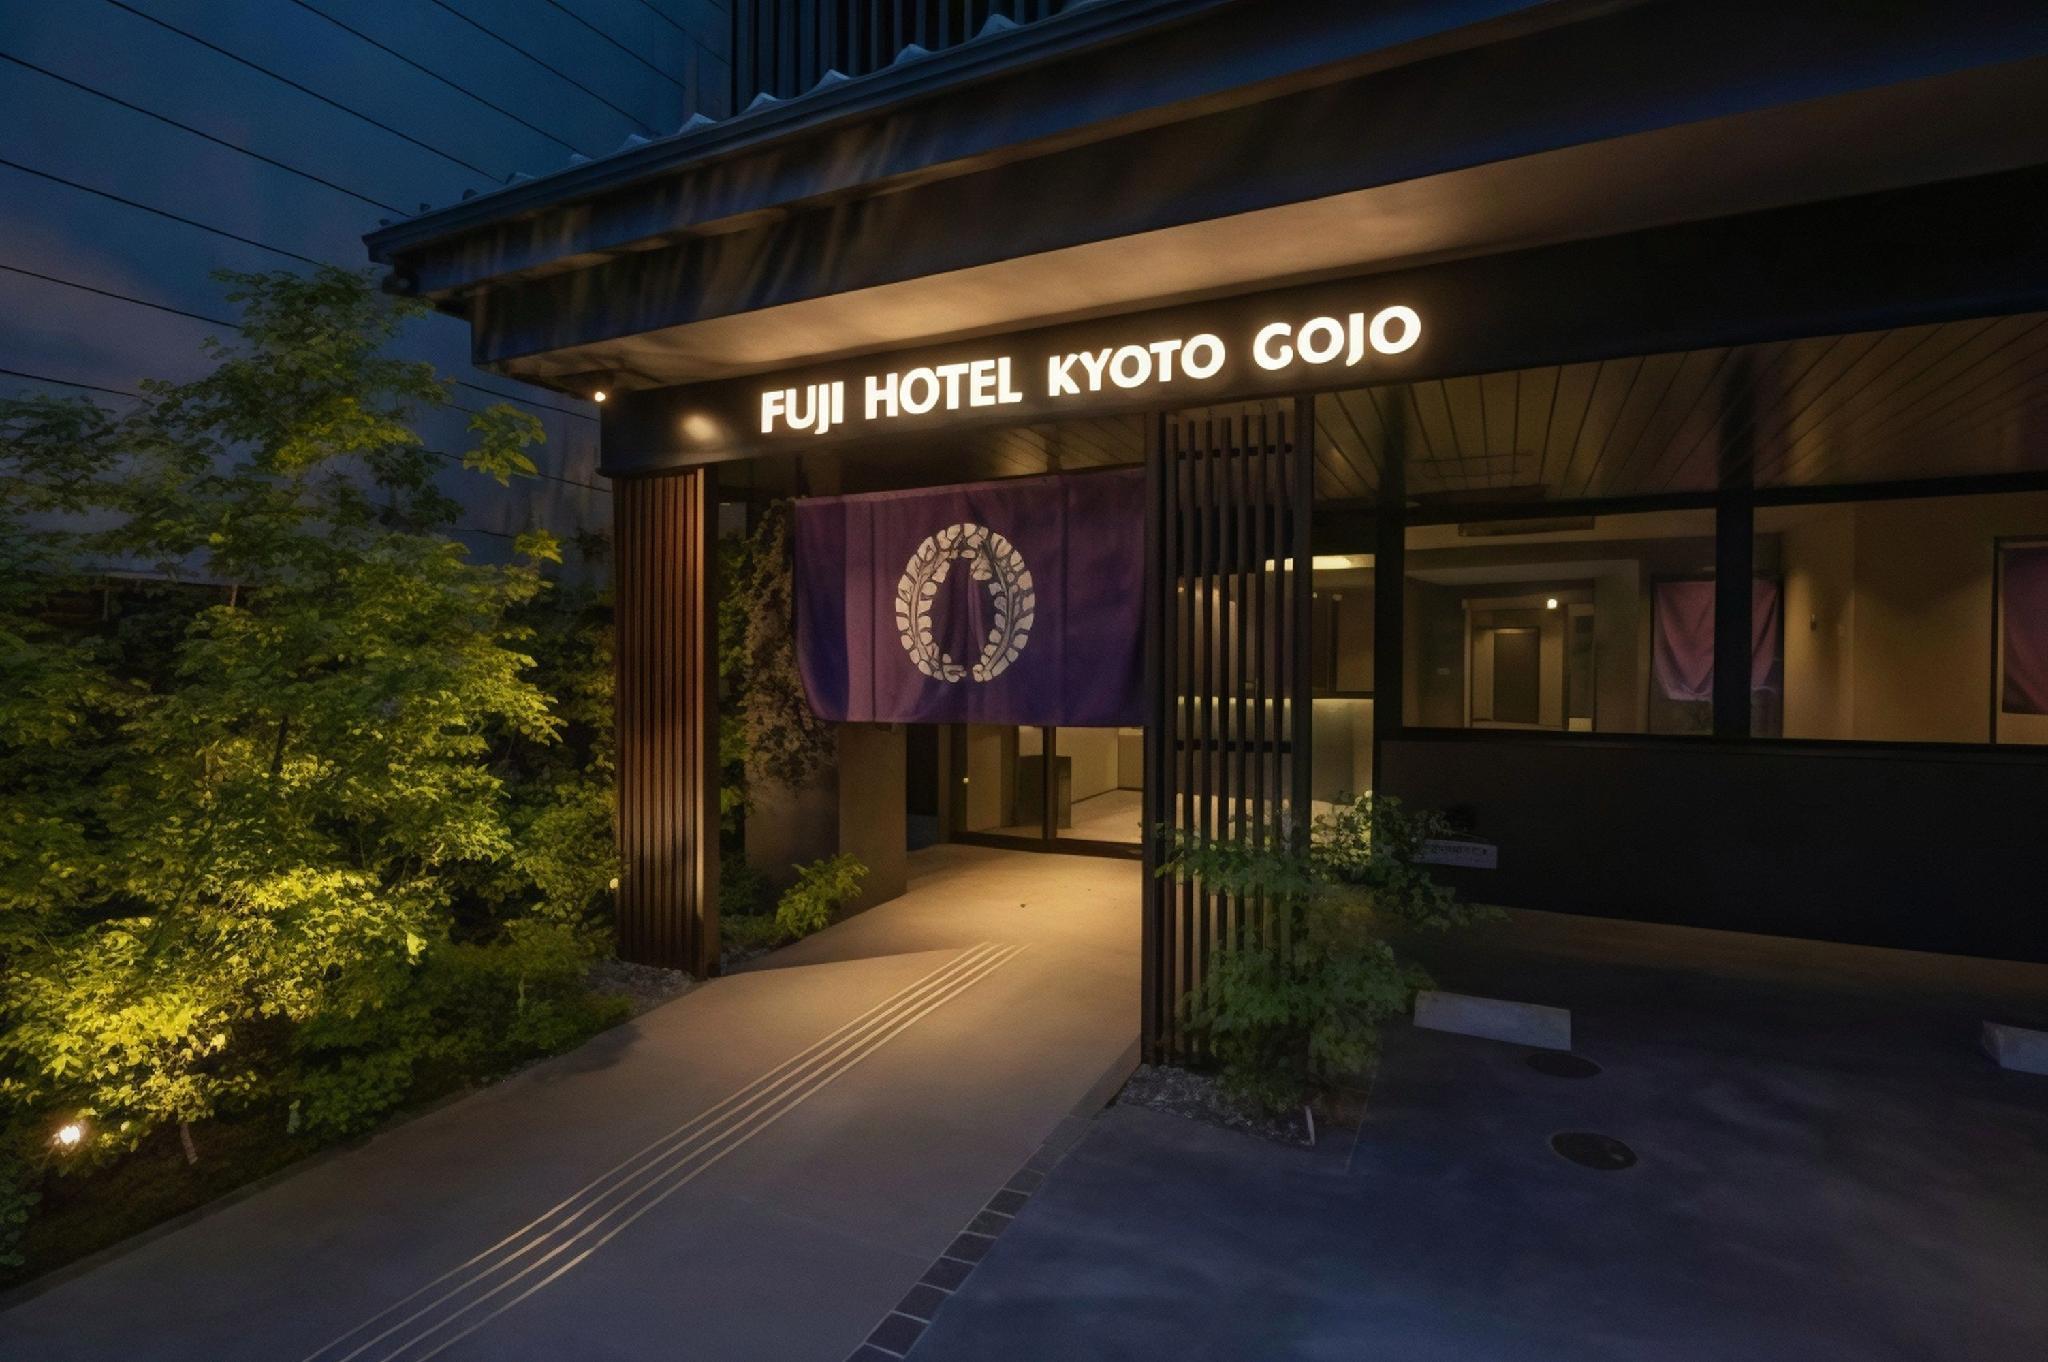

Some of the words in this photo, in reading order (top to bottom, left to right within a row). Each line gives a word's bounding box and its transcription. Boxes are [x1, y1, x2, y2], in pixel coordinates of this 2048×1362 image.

[761, 381, 844, 433] FUJI
[865, 357, 1023, 420] HOTEL
[1048, 334, 1226, 397] KYOTO
[1252, 306, 1422, 371] GOJO
